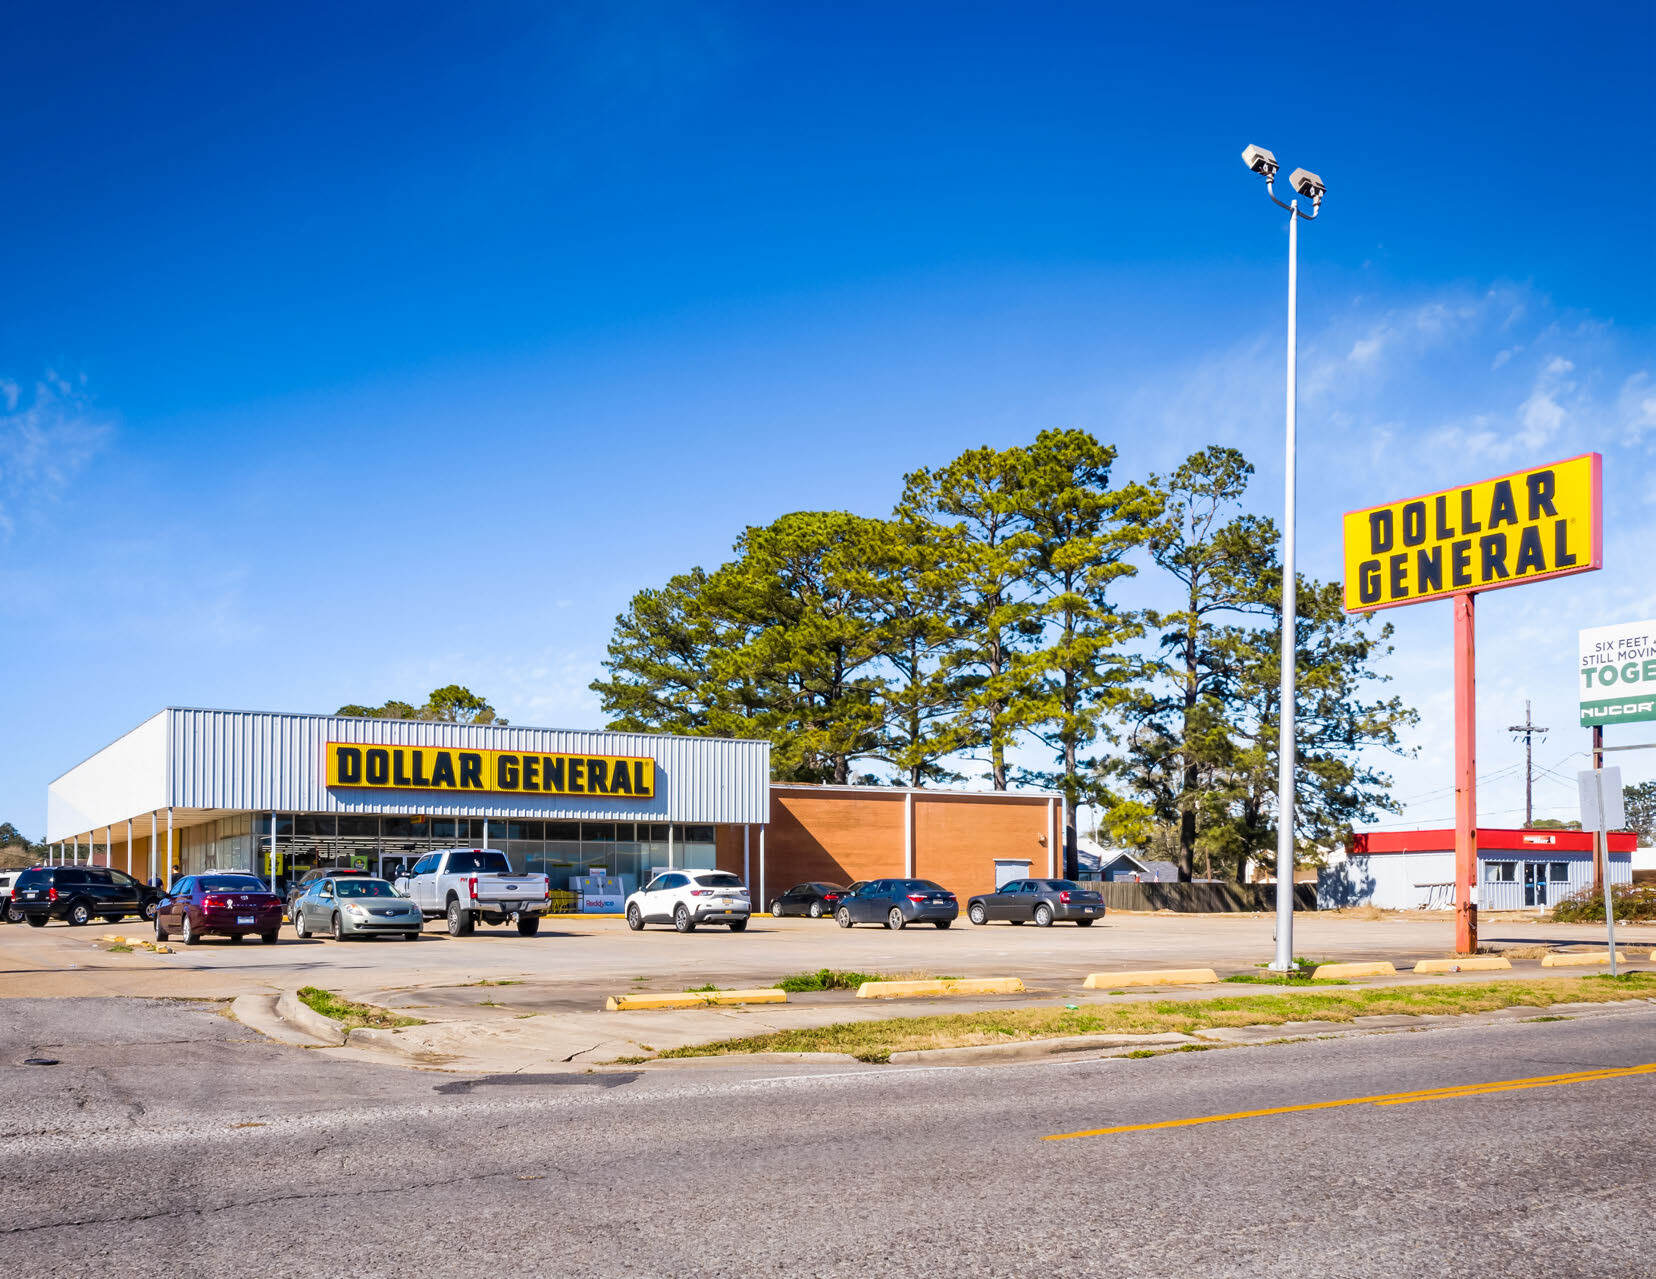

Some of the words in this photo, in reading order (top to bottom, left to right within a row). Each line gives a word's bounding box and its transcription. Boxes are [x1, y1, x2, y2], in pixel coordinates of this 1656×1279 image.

[1369, 470, 1558, 554] DOLLAR
[1359, 519, 1577, 604] GENERAL
[1595, 641, 1614, 652] SIX
[1619, 636, 1649, 649] FEET
[1580, 659, 1656, 688] TOGE
[1582, 653, 1614, 666] STILL
[1581, 702, 1653, 718] NUCOR
[337, 747, 484, 789] DOLLAR
[497, 755, 650, 795] GENERAL
